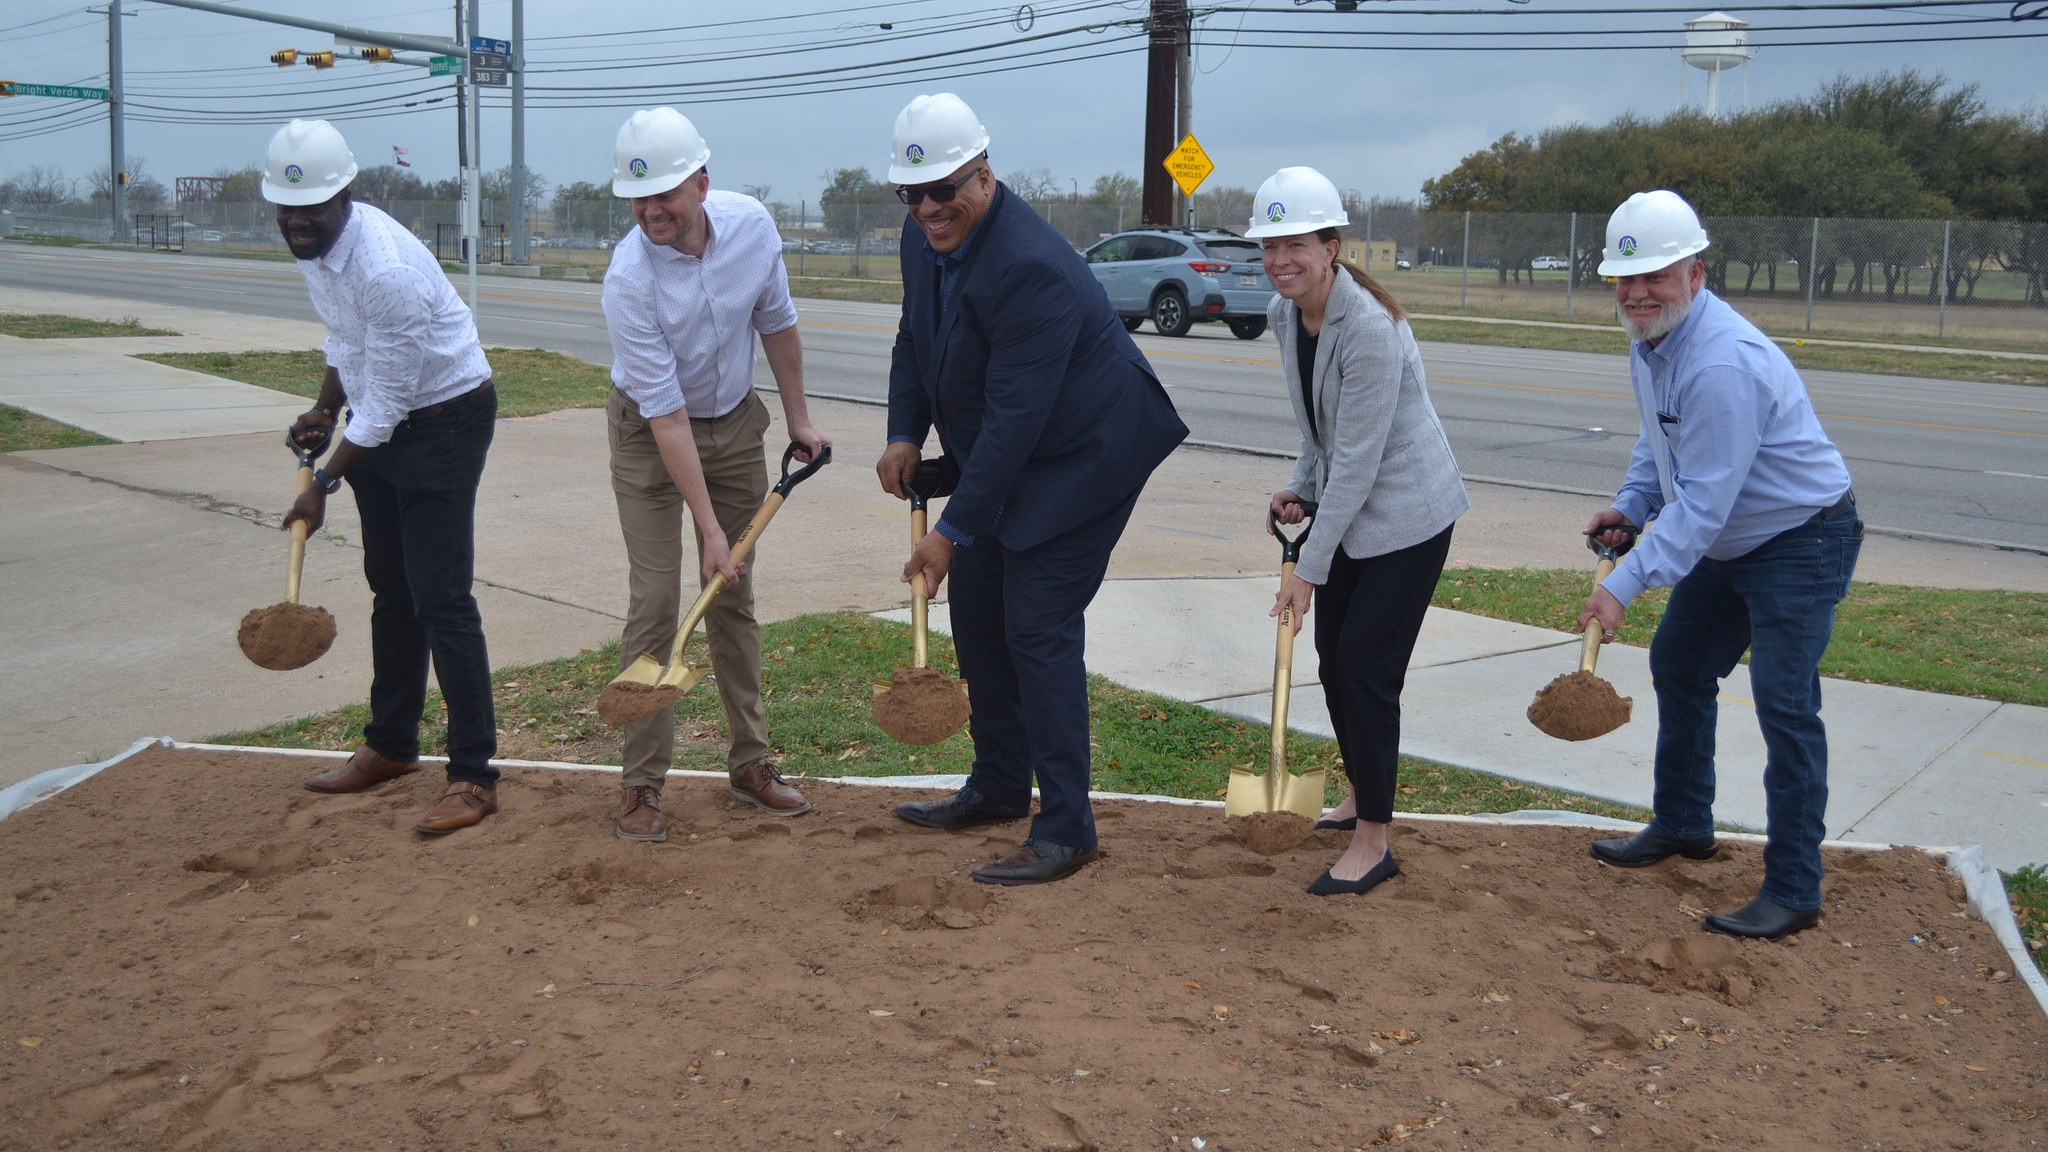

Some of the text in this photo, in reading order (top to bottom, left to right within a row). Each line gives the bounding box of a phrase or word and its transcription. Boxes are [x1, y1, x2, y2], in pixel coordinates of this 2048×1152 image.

[480, 56, 486, 65] 3
[430, 60, 448, 72] Burnet
[476, 72, 490, 82] 383
[16, 84, 104, 99] Bright Verde Way
[1172, 162, 1205, 171] EMERGENCY
[1176, 171, 1202, 179] VEHICLES
